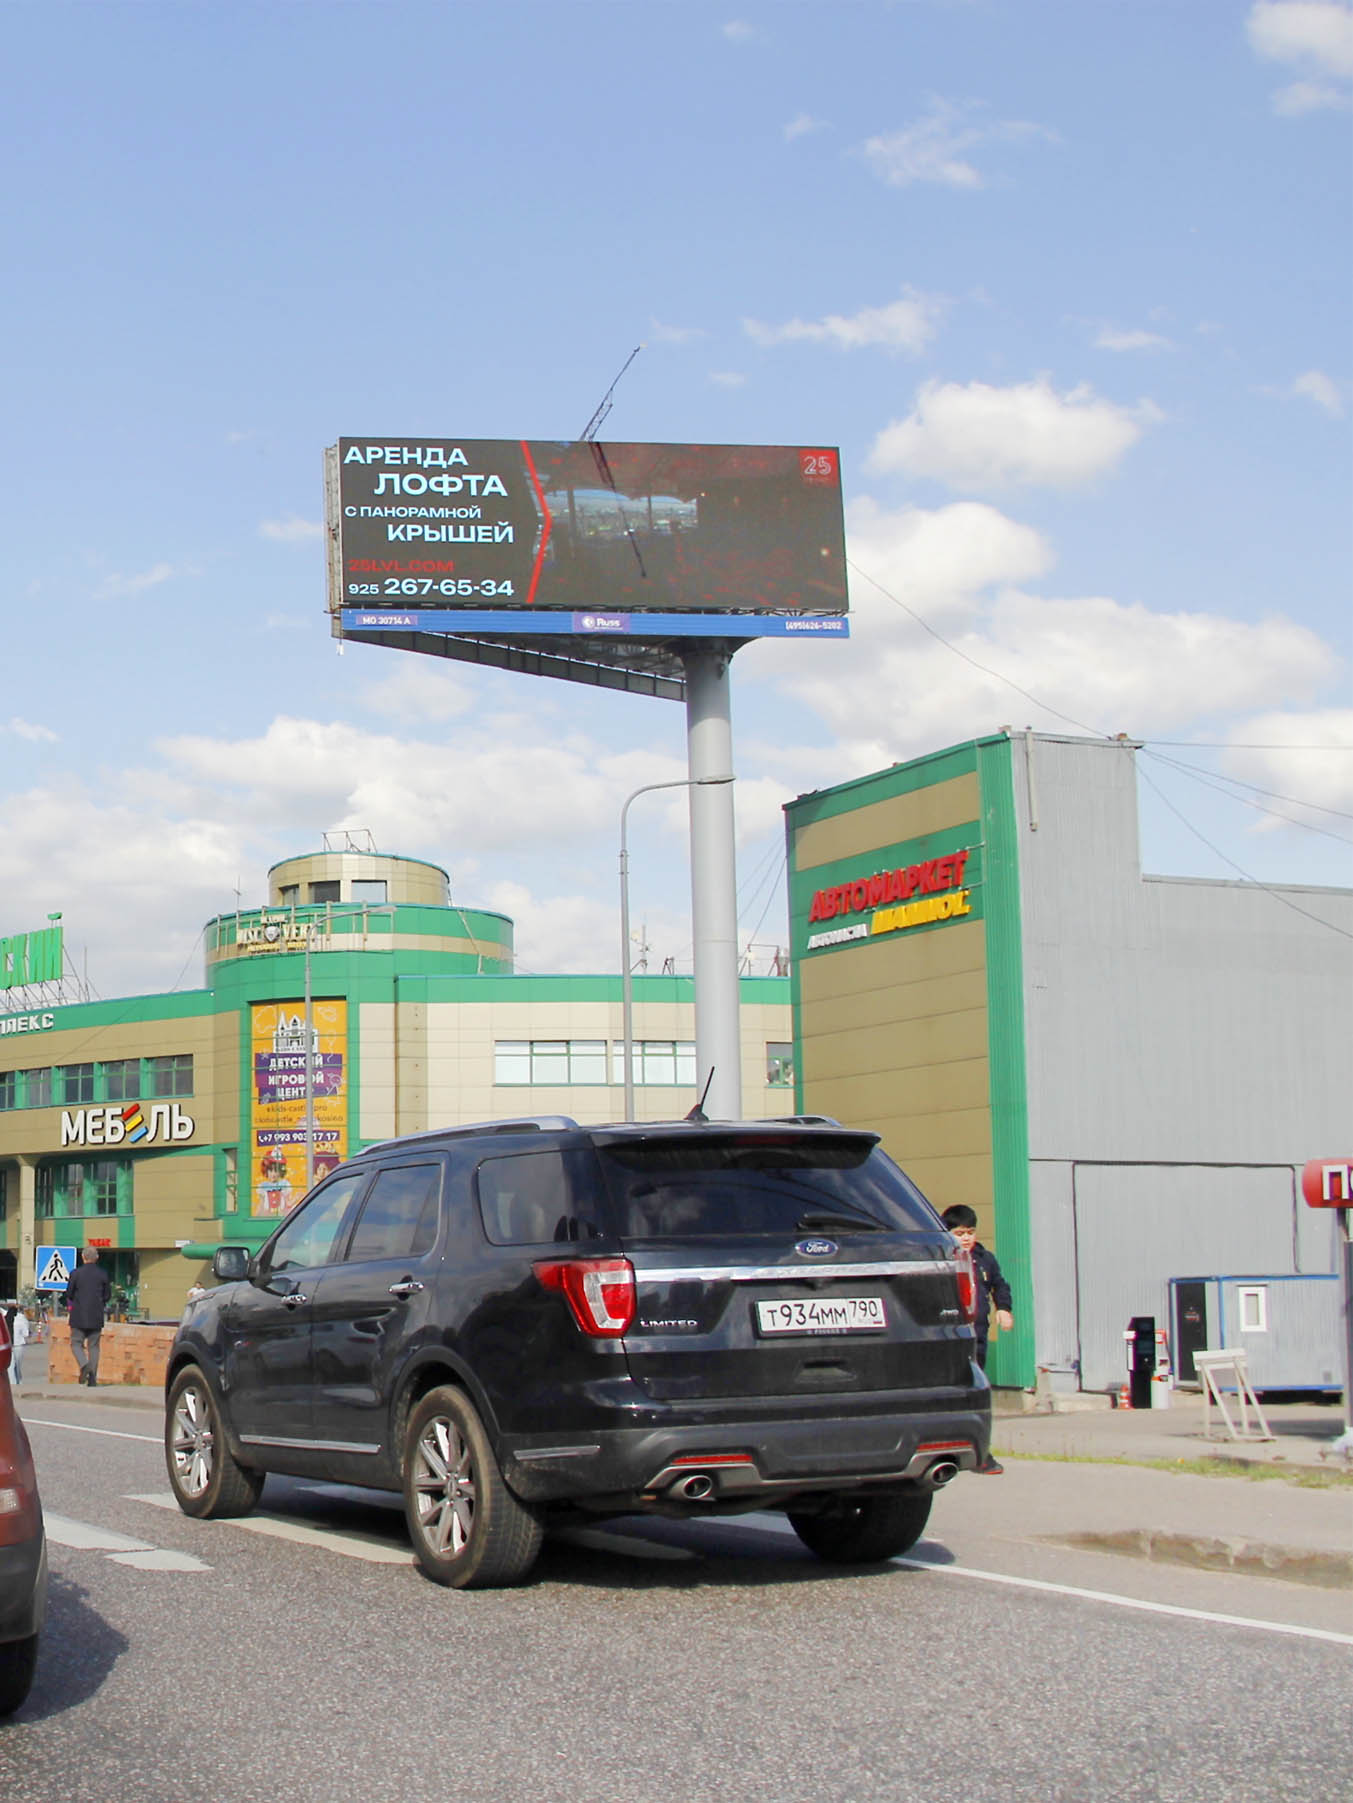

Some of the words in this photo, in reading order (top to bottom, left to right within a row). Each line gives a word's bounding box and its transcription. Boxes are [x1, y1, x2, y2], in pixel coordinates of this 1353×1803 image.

[344, 446, 469, 469] АРЕНДА
[804, 455, 832, 475] 25
[374, 473, 508, 497] ЛОФТА
[344, 506, 357, 517] С
[360, 505, 481, 519] ПАНОРАМНОЙ
[387, 521, 514, 543] КРЫШЕЙ
[349, 583, 379, 595] 925
[384, 578, 514, 596] 267-65-34
[808, 850, 969, 922] АВТОМАРКЕТ
[276, 1086, 314, 1100] ЦЕНТ
[61, 1104, 195, 1147] МЕБЕЛЬ
[274, 1133, 290, 1142] 993
[326, 1132, 338, 1141] 17
[1322, 1165, 1353, 1200] П
[806, 1241, 829, 1253] Ford
[639, 1317, 698, 1328] LIMITED
[767, 1303, 847, 1327] Т934ММ
[849, 1300, 879, 1318] 790
